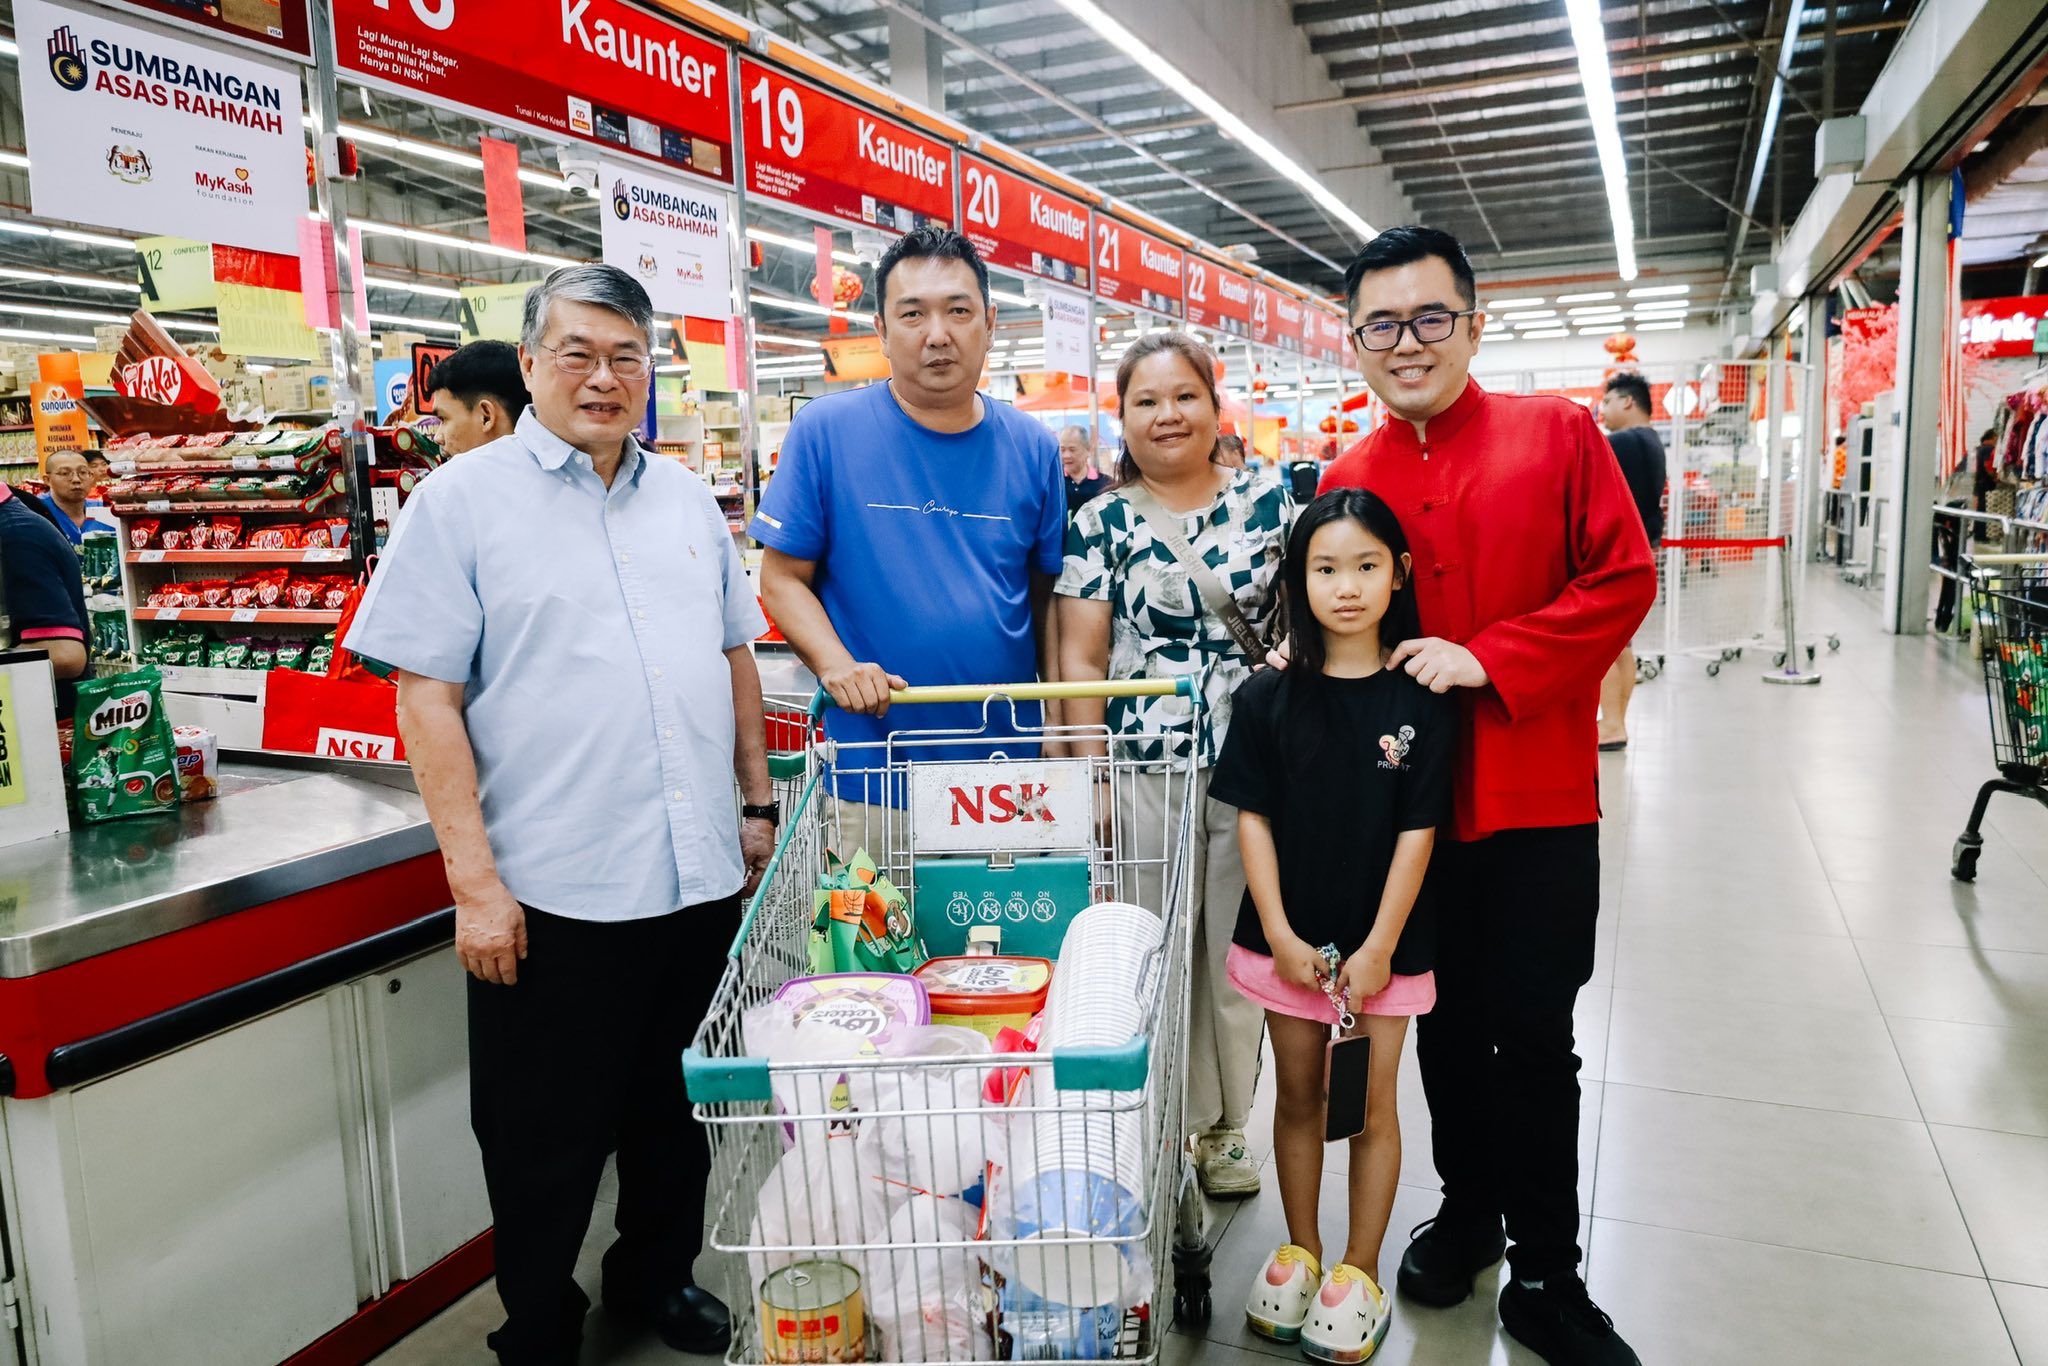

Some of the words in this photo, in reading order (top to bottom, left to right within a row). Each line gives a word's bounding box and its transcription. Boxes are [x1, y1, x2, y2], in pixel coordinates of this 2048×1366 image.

[358, 25, 378, 42] Lagi
[380, 33, 409, 51] Murah
[411, 43, 431, 60] Lagi
[359, 39, 395, 59] Dengan
[397, 52, 417, 67] Nilai
[419, 59, 447, 78] Hebat,
[561, 0, 717, 99] Kaunter
[90, 39, 281, 111] SUMBANGAN
[360, 53, 389, 71] Hanya
[392, 63, 402, 75] Di
[404, 67, 424, 83] NSK
[95, 70, 168, 107] ASAS
[173, 89, 282, 135] RAHMAH
[515, 104, 532, 118] Tunai
[536, 111, 549, 123] Kad
[751, 76, 804, 158] 19
[858, 118, 946, 188] Kaunter
[195, 171, 252, 195] MyKasih
[196, 188, 254, 206] foundation
[966, 167, 999, 229] 20
[631, 185, 717, 222] SUMBANGAN
[633, 205, 665, 226] ASAS
[667, 214, 718, 238] RAHMAH
[1030, 191, 1086, 241] Kaunter
[147, 249, 163, 271] 12
[1098, 223, 1119, 272] 21
[1140, 240, 1180, 279] Kaunter
[1188, 262, 1206, 302] 22
[1218, 273, 1249, 304] Kaunter
[472, 296, 486, 313] 10
[132, 358, 179, 402] KitKat
[95, 702, 148, 731] MILO
[327, 737, 383, 760] NSK
[948, 783, 1056, 825] NSK
